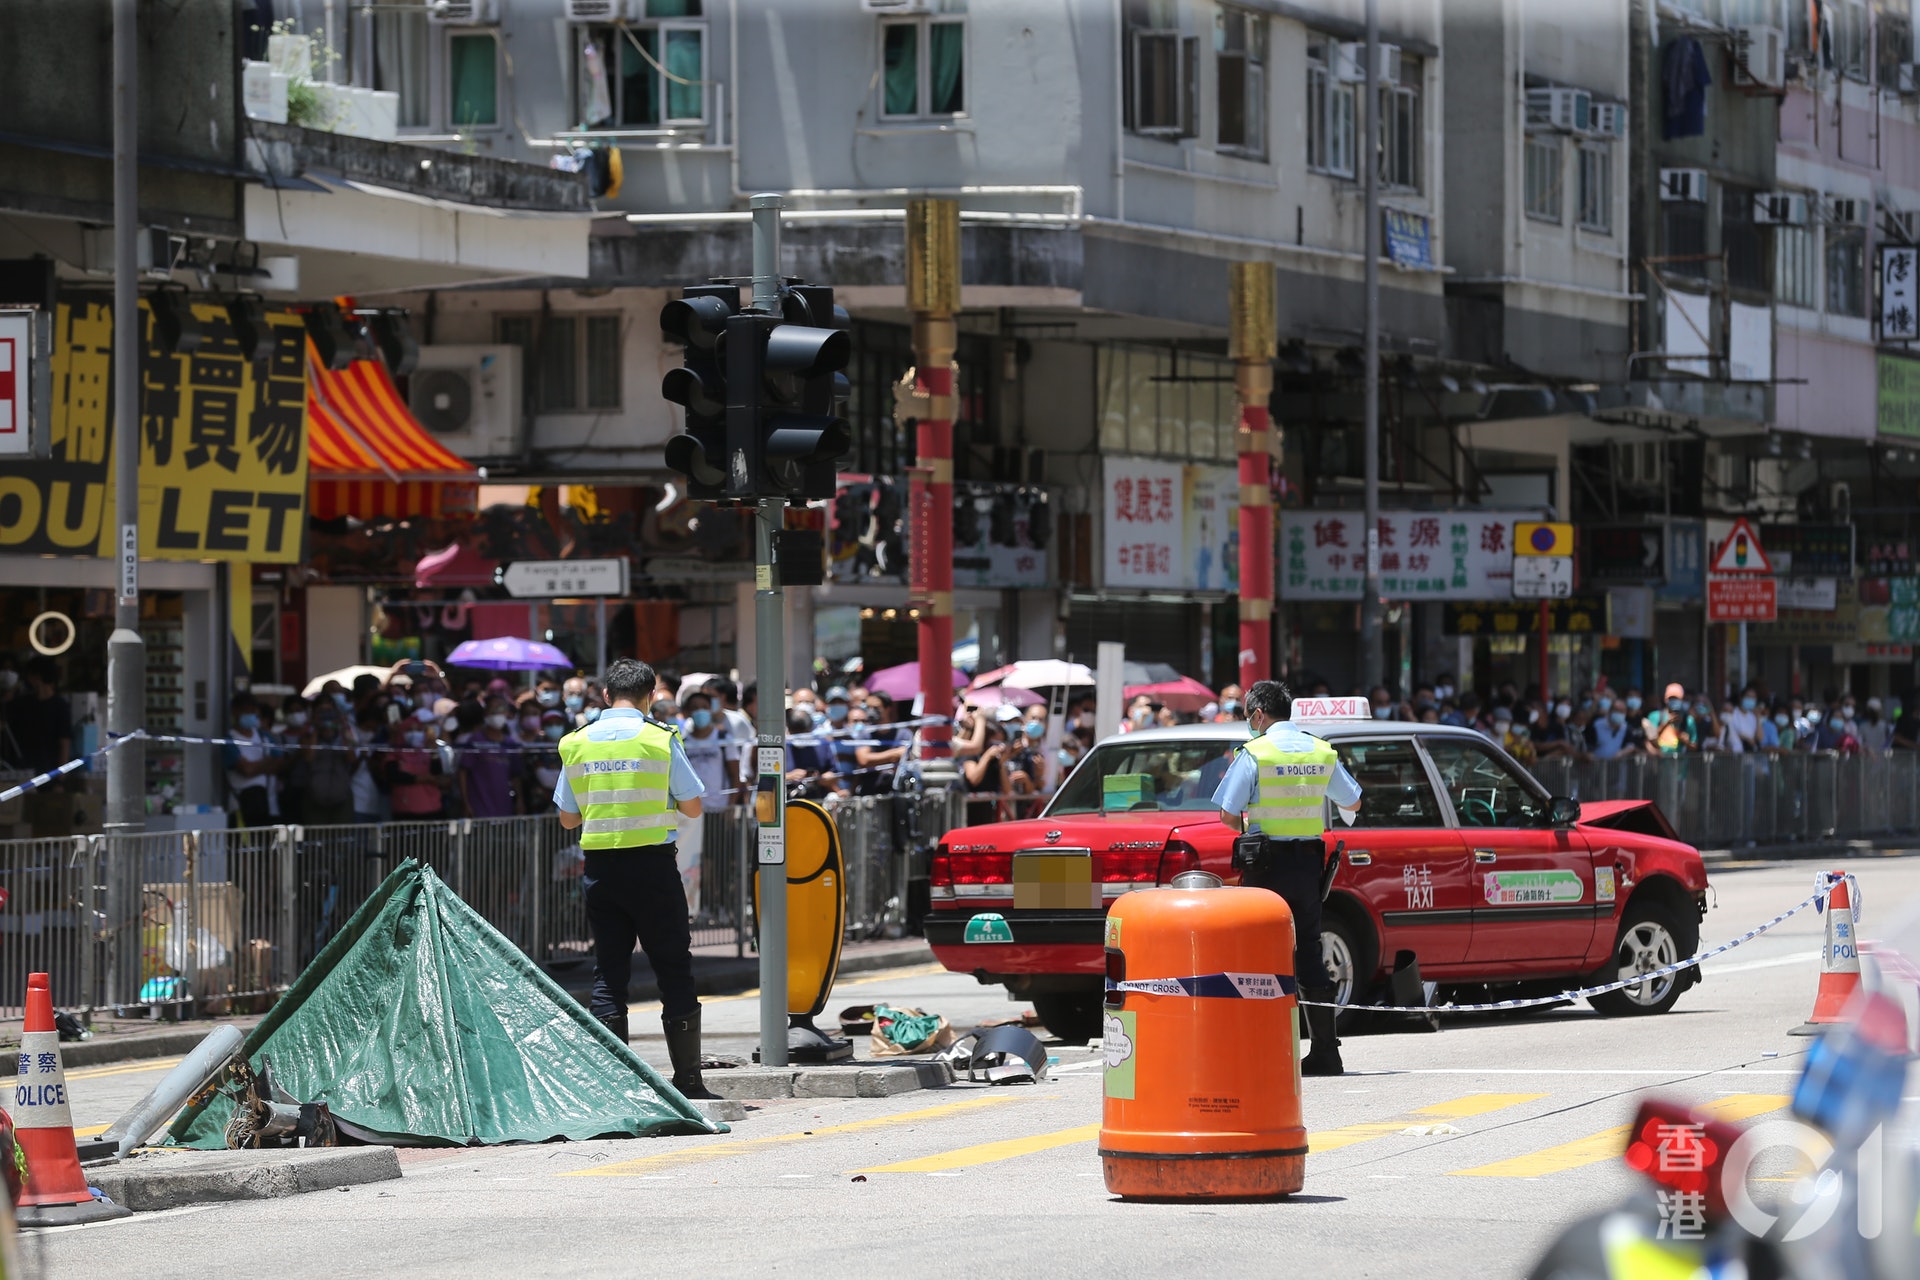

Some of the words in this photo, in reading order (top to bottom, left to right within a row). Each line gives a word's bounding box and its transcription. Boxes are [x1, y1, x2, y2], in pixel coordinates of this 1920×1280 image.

[0, 477, 301, 552] OULET
[1551, 559, 1560, 572] 7
[1552, 583, 1568, 595] 12
[1297, 700, 1356, 716] TAXI
[594, 761, 626, 771] POLICE
[1288, 766, 1317, 775] POLICE
[1404, 865, 1432, 886] 的士
[1405, 887, 1433, 908] TAXI
[982, 920, 993, 933] 4
[974, 933, 1003, 941] SEATS
[1152, 985, 1180, 993] CROSS
[18, 1051, 57, 1075] 警察
[15, 1084, 65, 1106] OLICE
